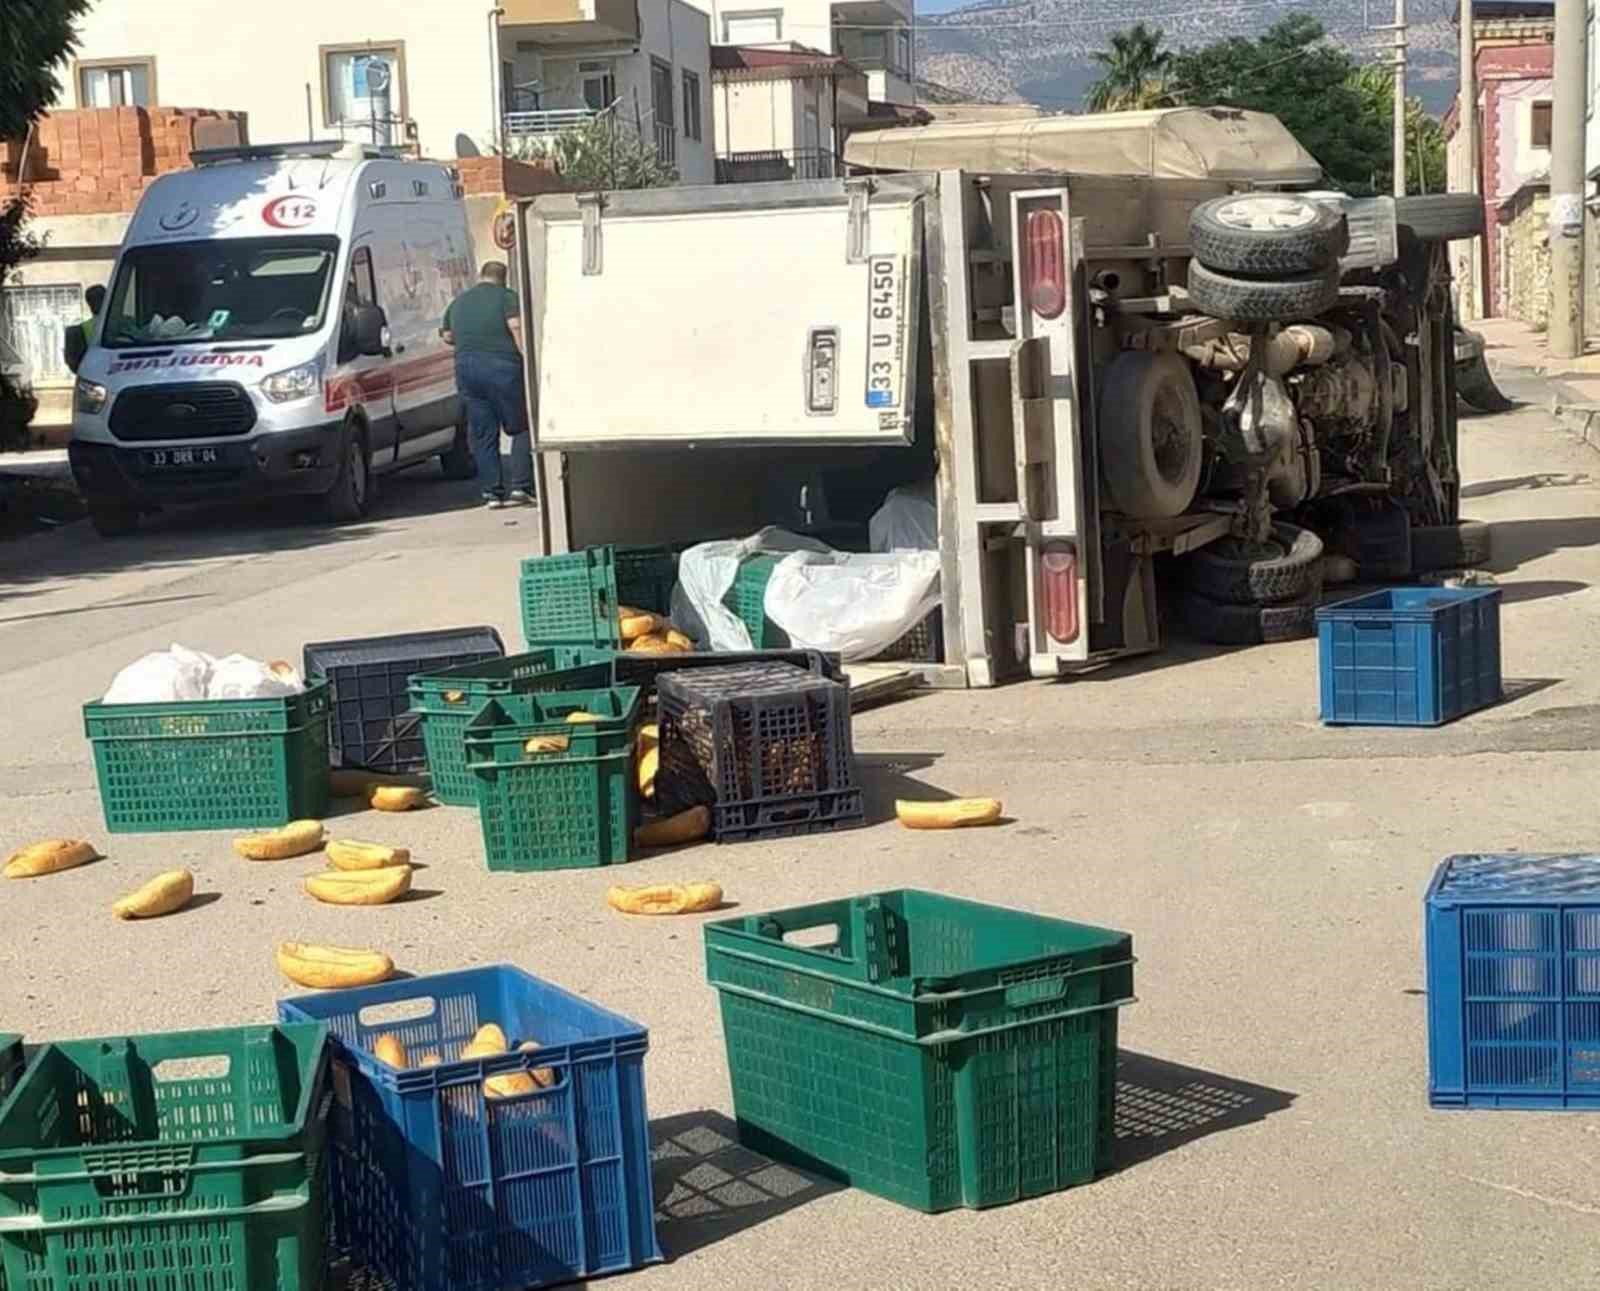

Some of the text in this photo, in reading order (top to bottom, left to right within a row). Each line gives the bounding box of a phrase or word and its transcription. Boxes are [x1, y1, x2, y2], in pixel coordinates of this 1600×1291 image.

[278, 204, 317, 219] 112
[873, 260, 894, 320] 6450
[872, 333, 893, 348] U
[871, 361, 893, 390] 33
